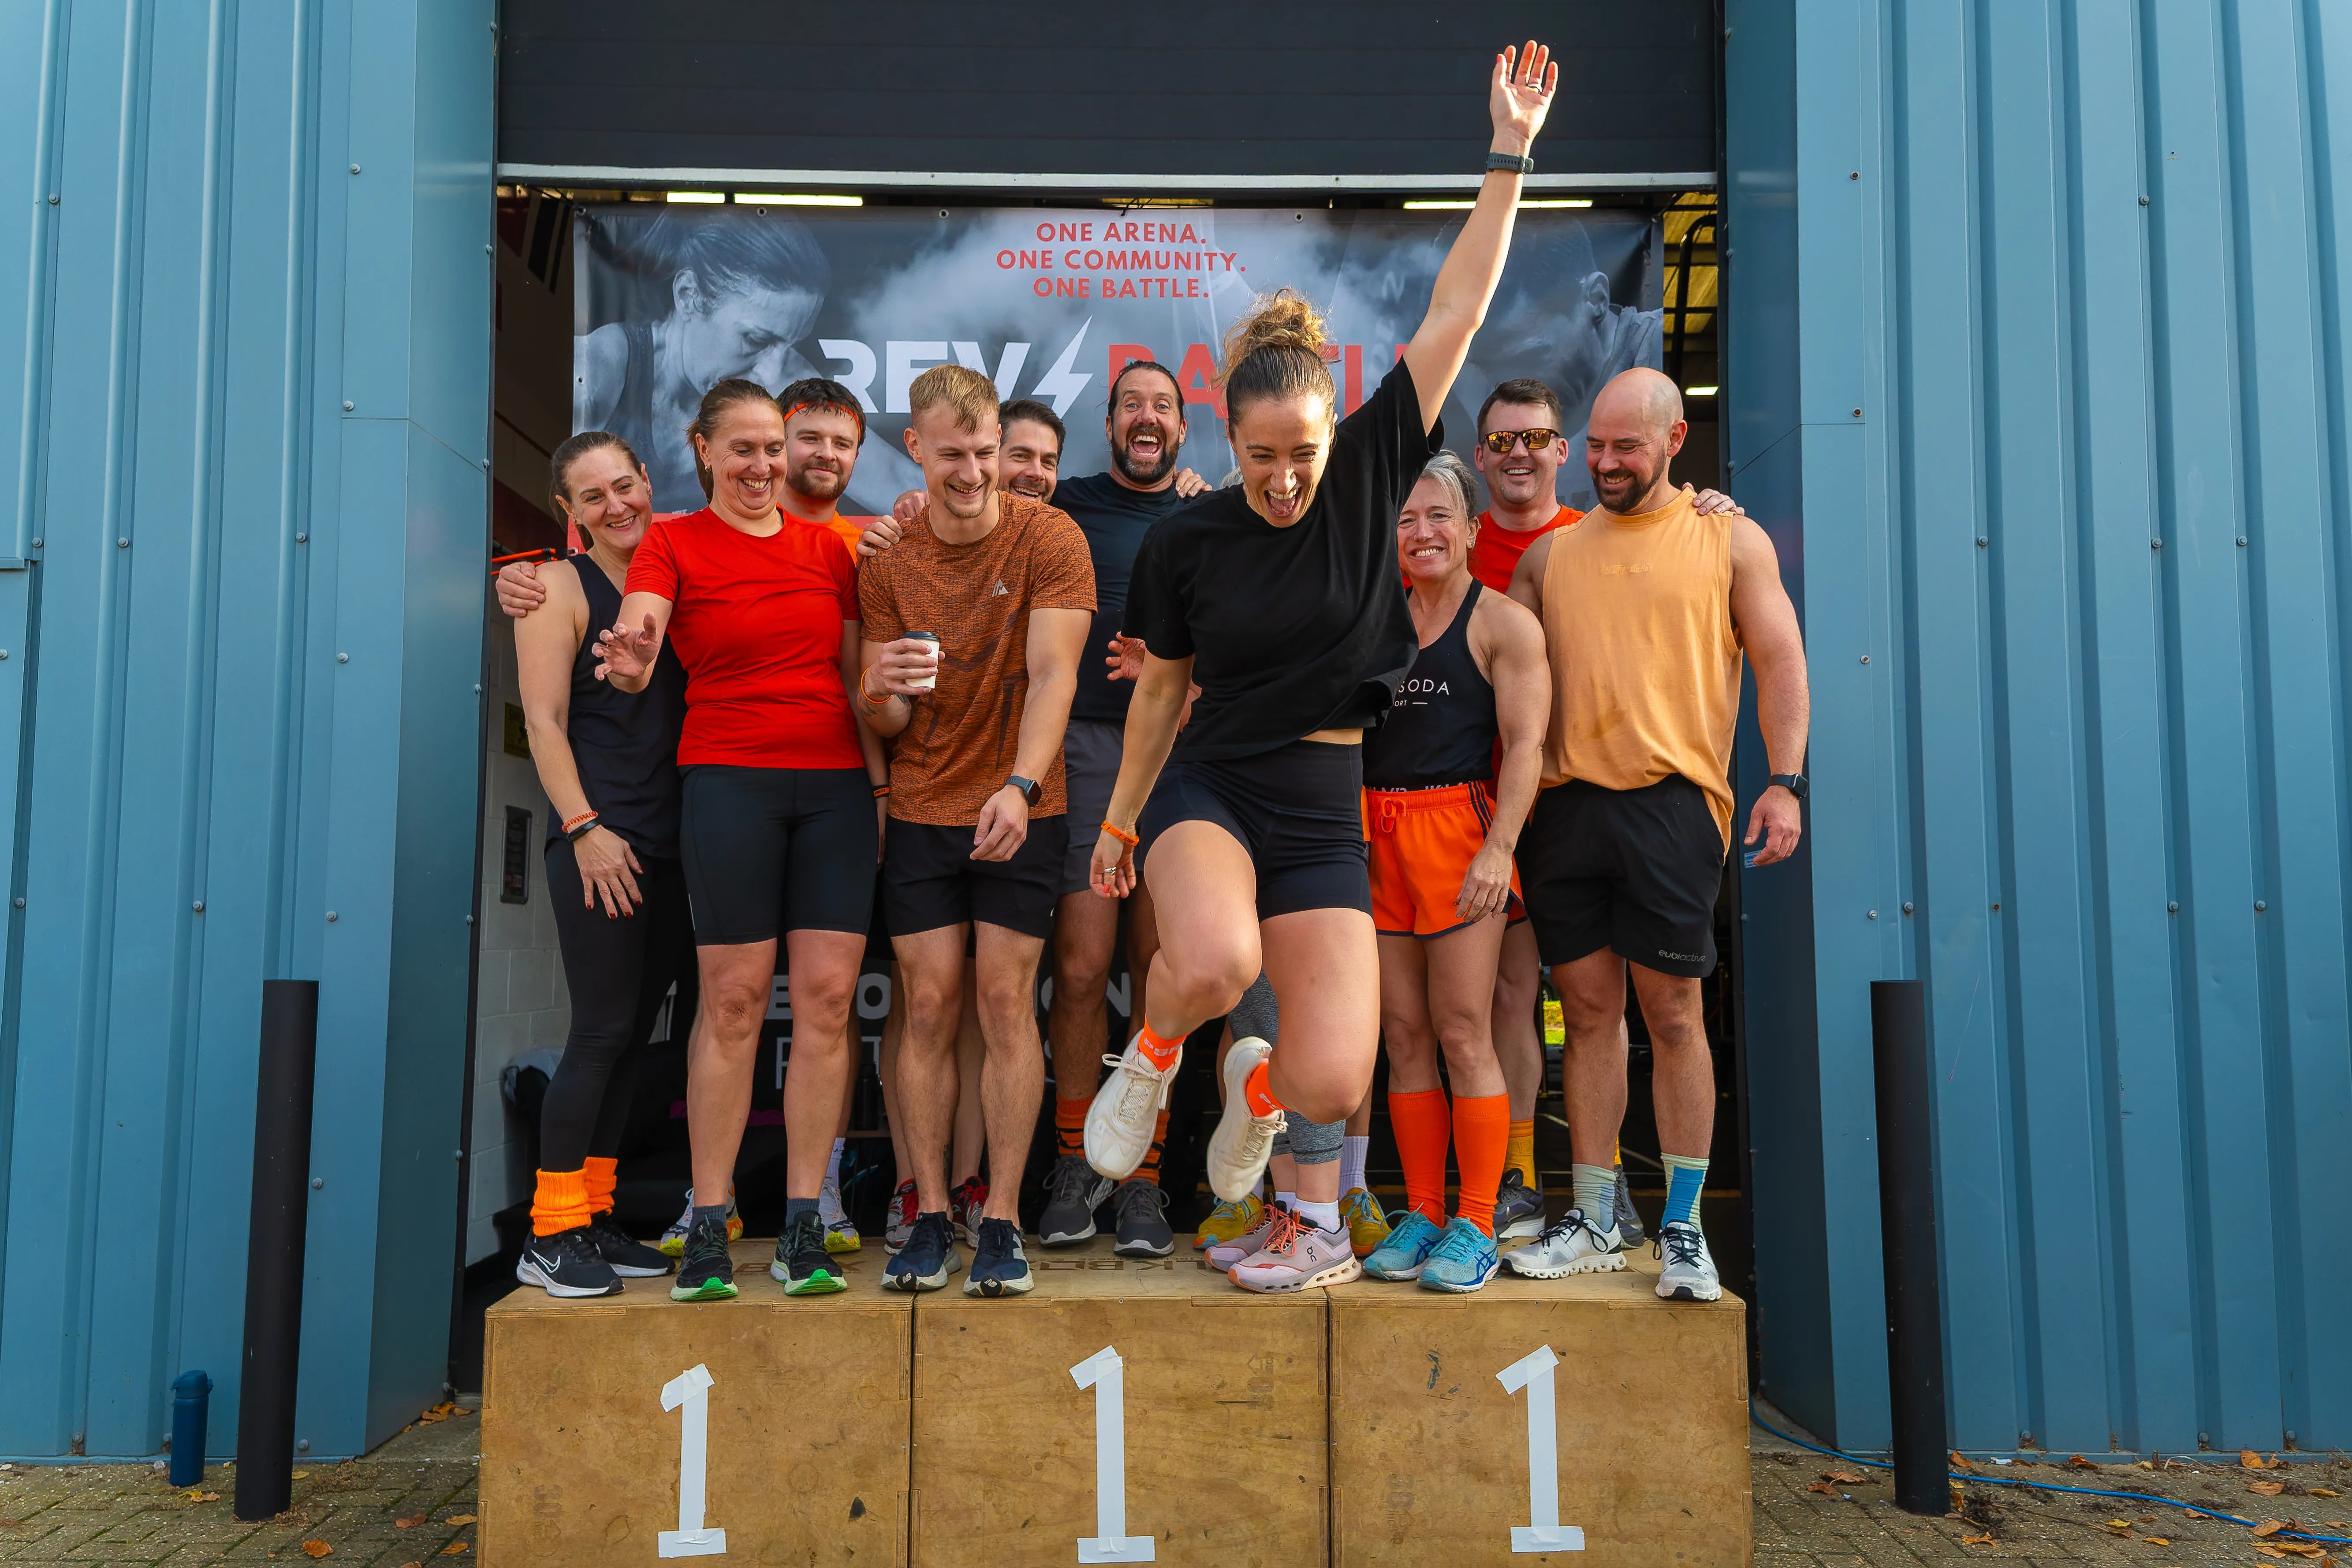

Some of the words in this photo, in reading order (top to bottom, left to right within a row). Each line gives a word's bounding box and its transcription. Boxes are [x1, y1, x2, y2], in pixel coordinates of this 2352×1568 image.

[996, 250, 1053, 270] ONE
[1064, 249, 1246, 272] COMMUNITY.
[1033, 277, 1090, 298] ONE
[1102, 278, 1209, 298] BATTLE.
[1036, 223, 1093, 242] ONE
[1103, 222, 1207, 244] ARENA.
[658, 1363, 727, 1559] 1
[1069, 1344, 1156, 1564] 1
[1495, 1344, 1586, 1553] 1
